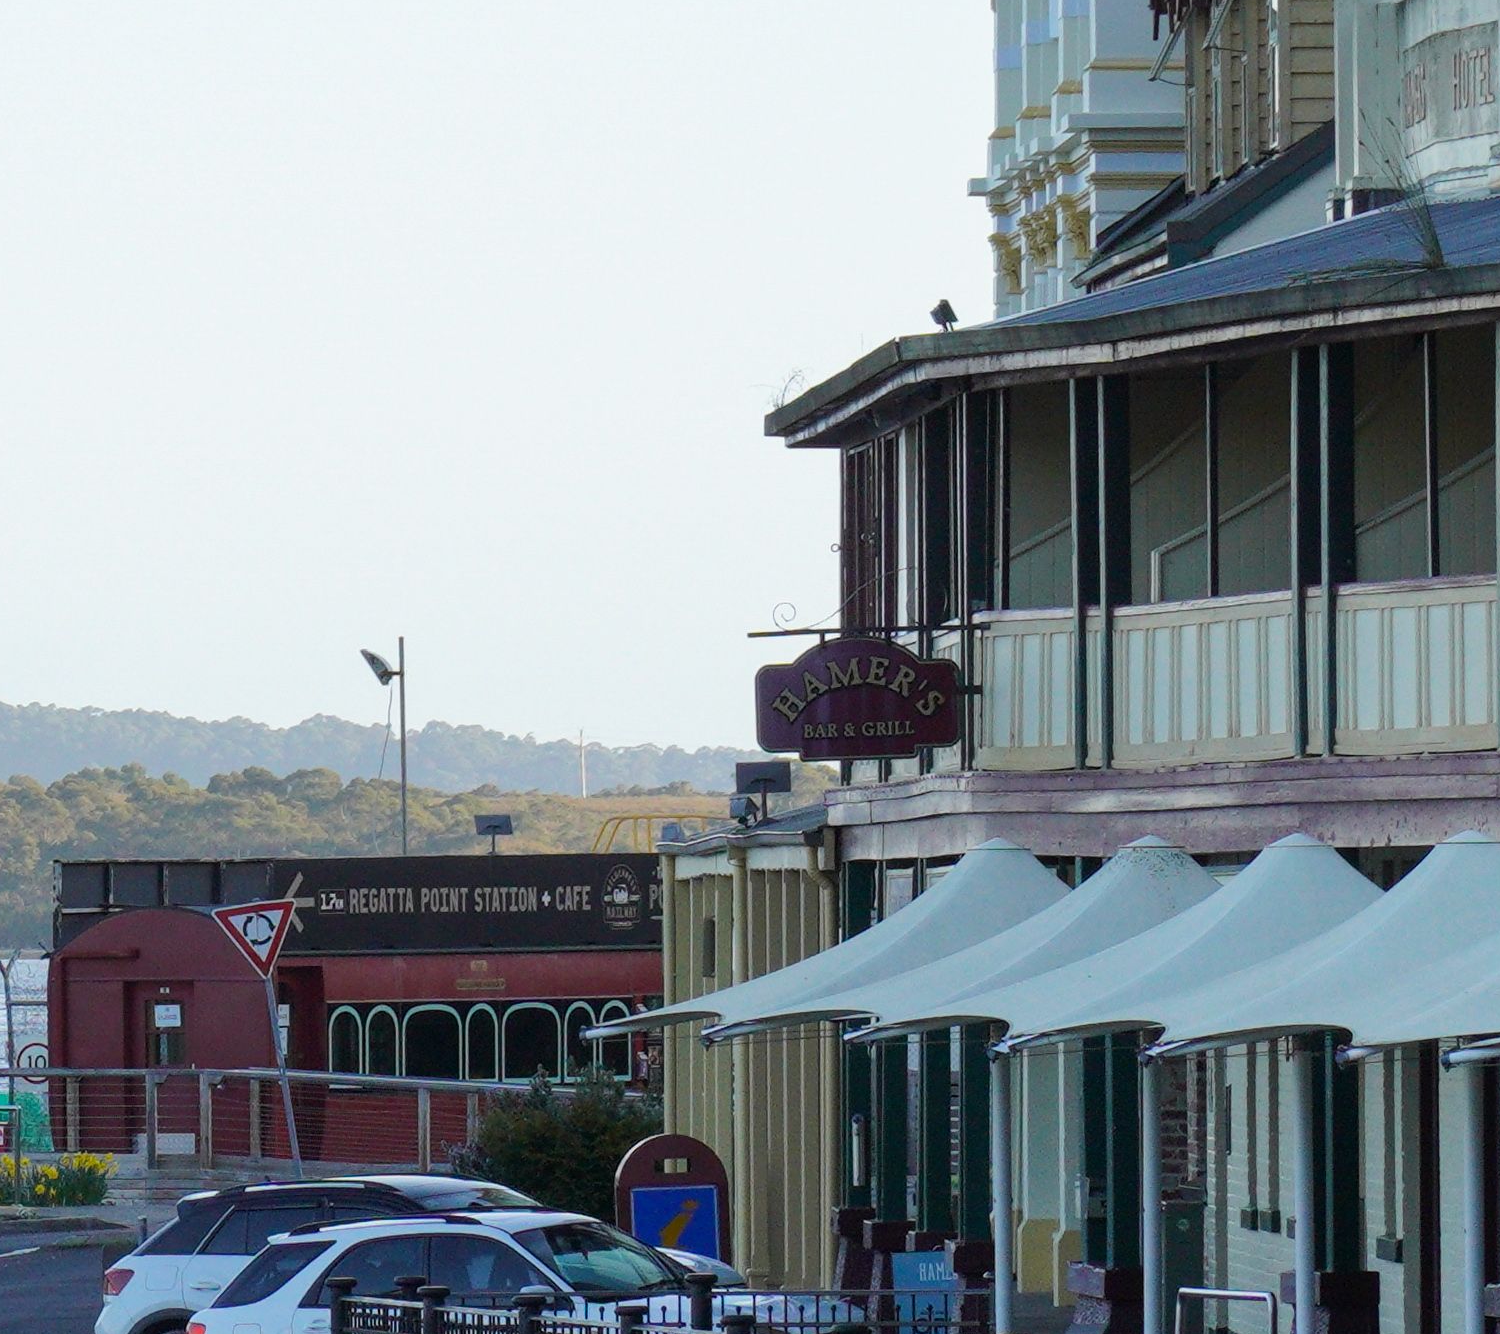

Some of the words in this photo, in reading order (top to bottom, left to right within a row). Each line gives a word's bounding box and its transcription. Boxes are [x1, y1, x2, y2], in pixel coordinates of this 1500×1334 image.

[1453, 46, 1495, 111] HOTEL
[771, 656, 945, 722] HAMER'S
[804, 722, 837, 739] BAR
[844, 722, 856, 737] &
[862, 720, 915, 737] GRILL
[349, 887, 414, 915] REGATTA
[420, 887, 468, 914] POINT
[474, 886, 538, 913] STATION
[556, 886, 591, 912] CAFE
